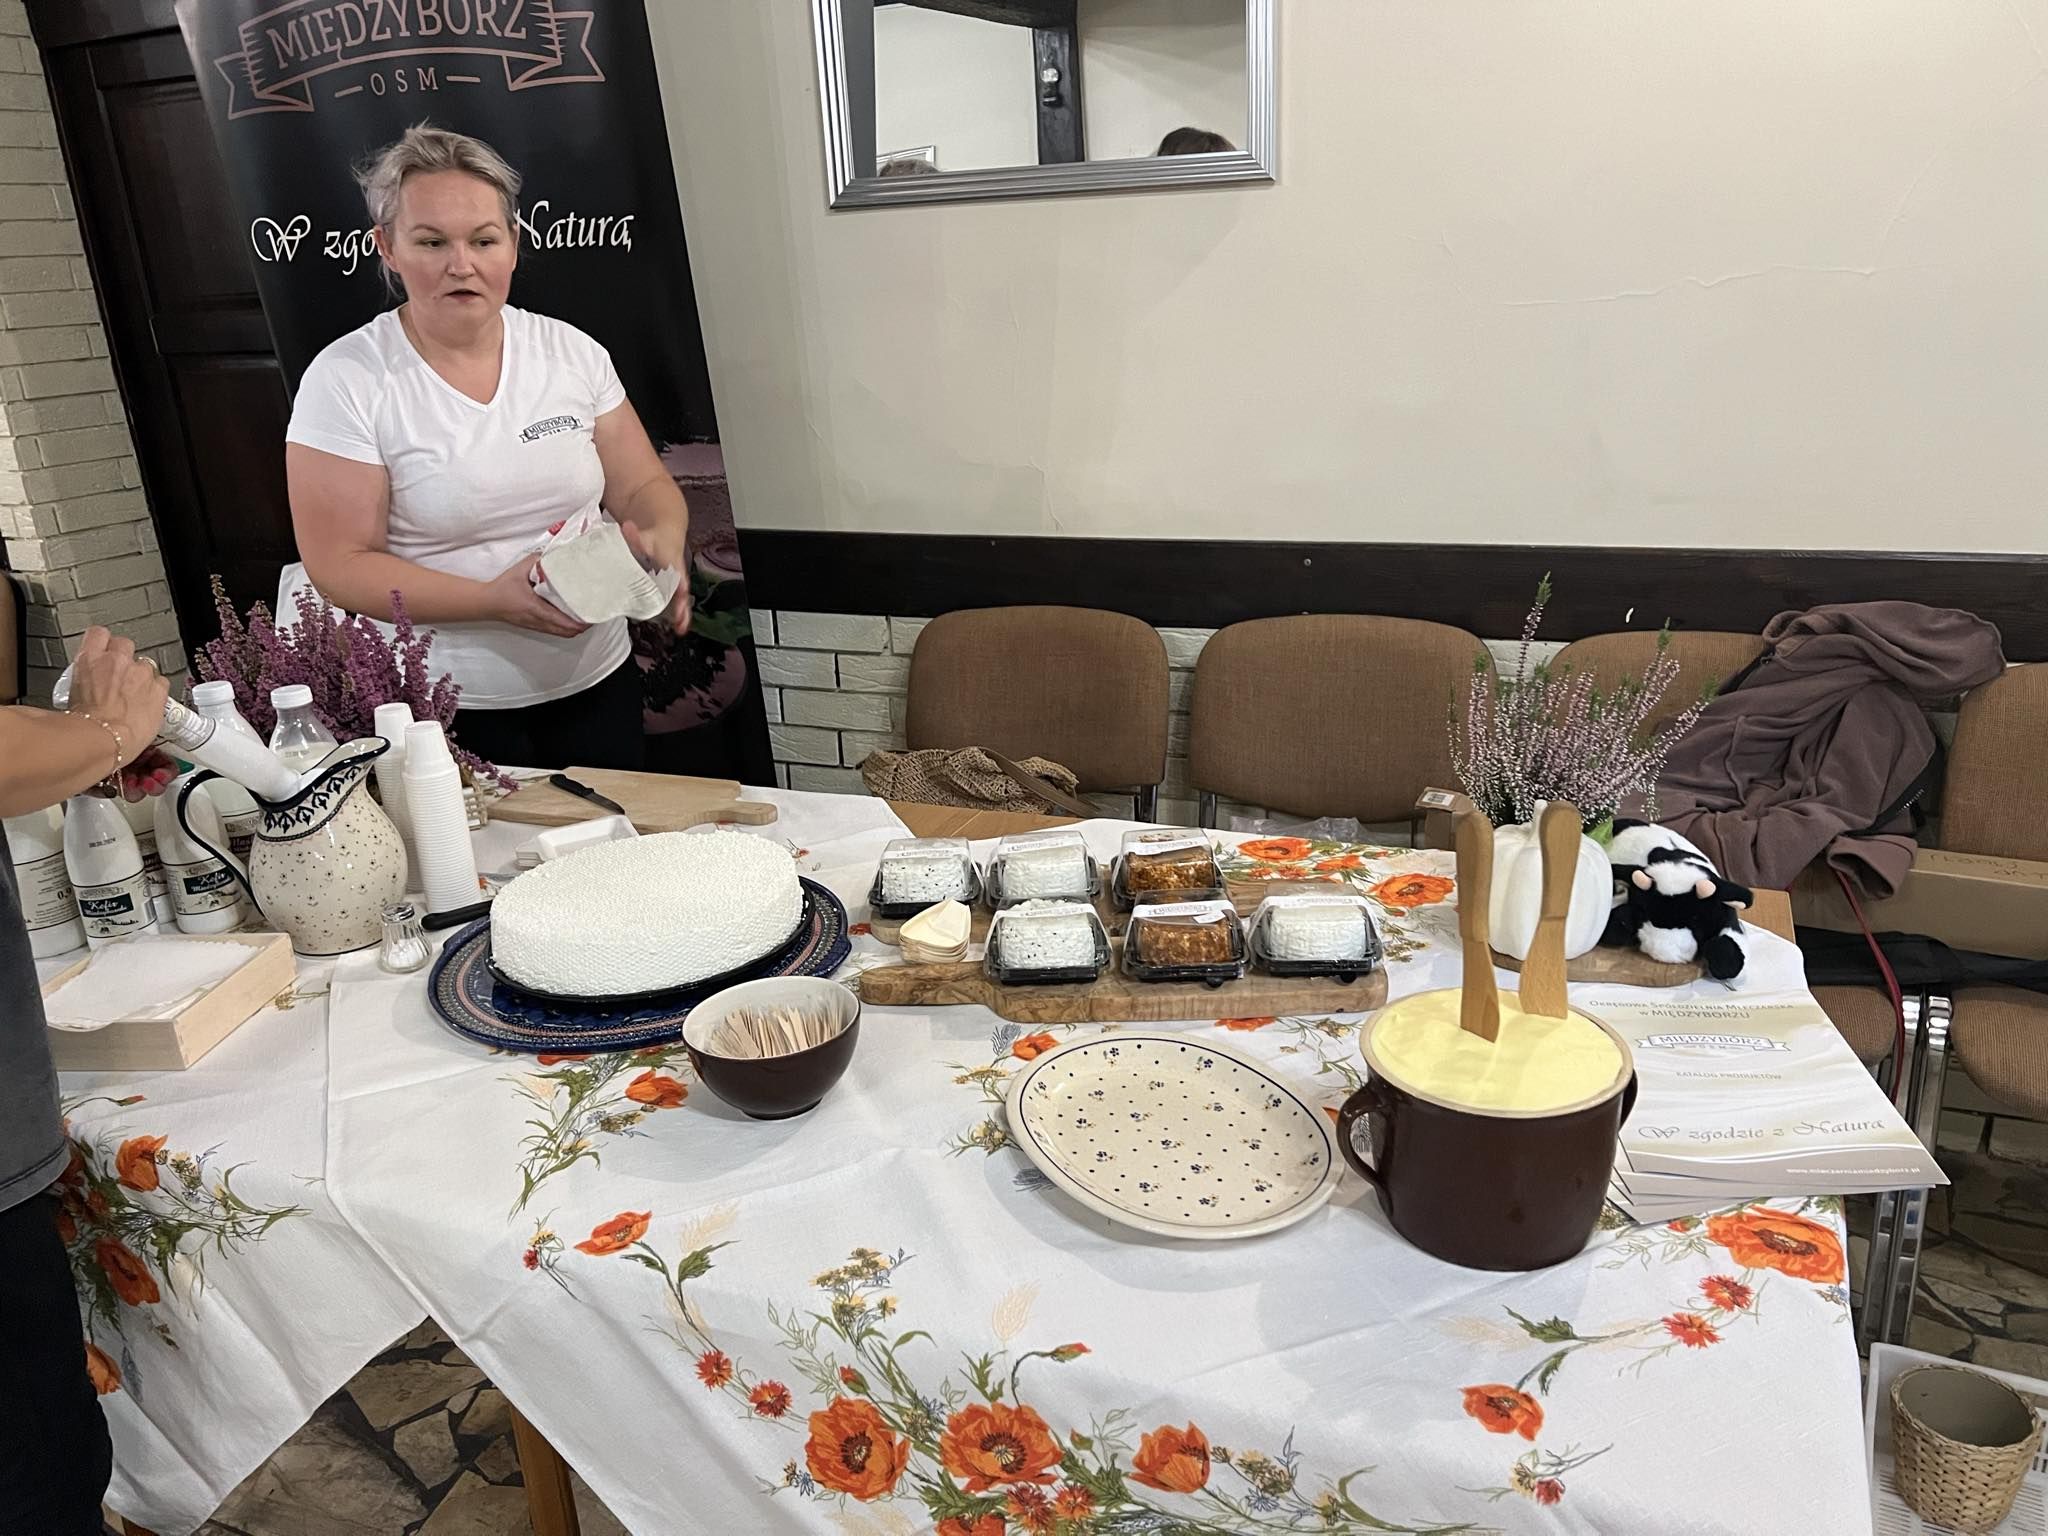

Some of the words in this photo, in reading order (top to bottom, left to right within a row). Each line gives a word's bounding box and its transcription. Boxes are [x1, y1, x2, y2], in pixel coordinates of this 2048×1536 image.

[370, 67, 439, 96] OSM
[251, 214, 311, 262] W
[323, 229, 384, 276] zgo
[1638, 1125, 1681, 1140] W
[1688, 1126, 1764, 1144] zgodzie
[1773, 1129, 1785, 1138] z
